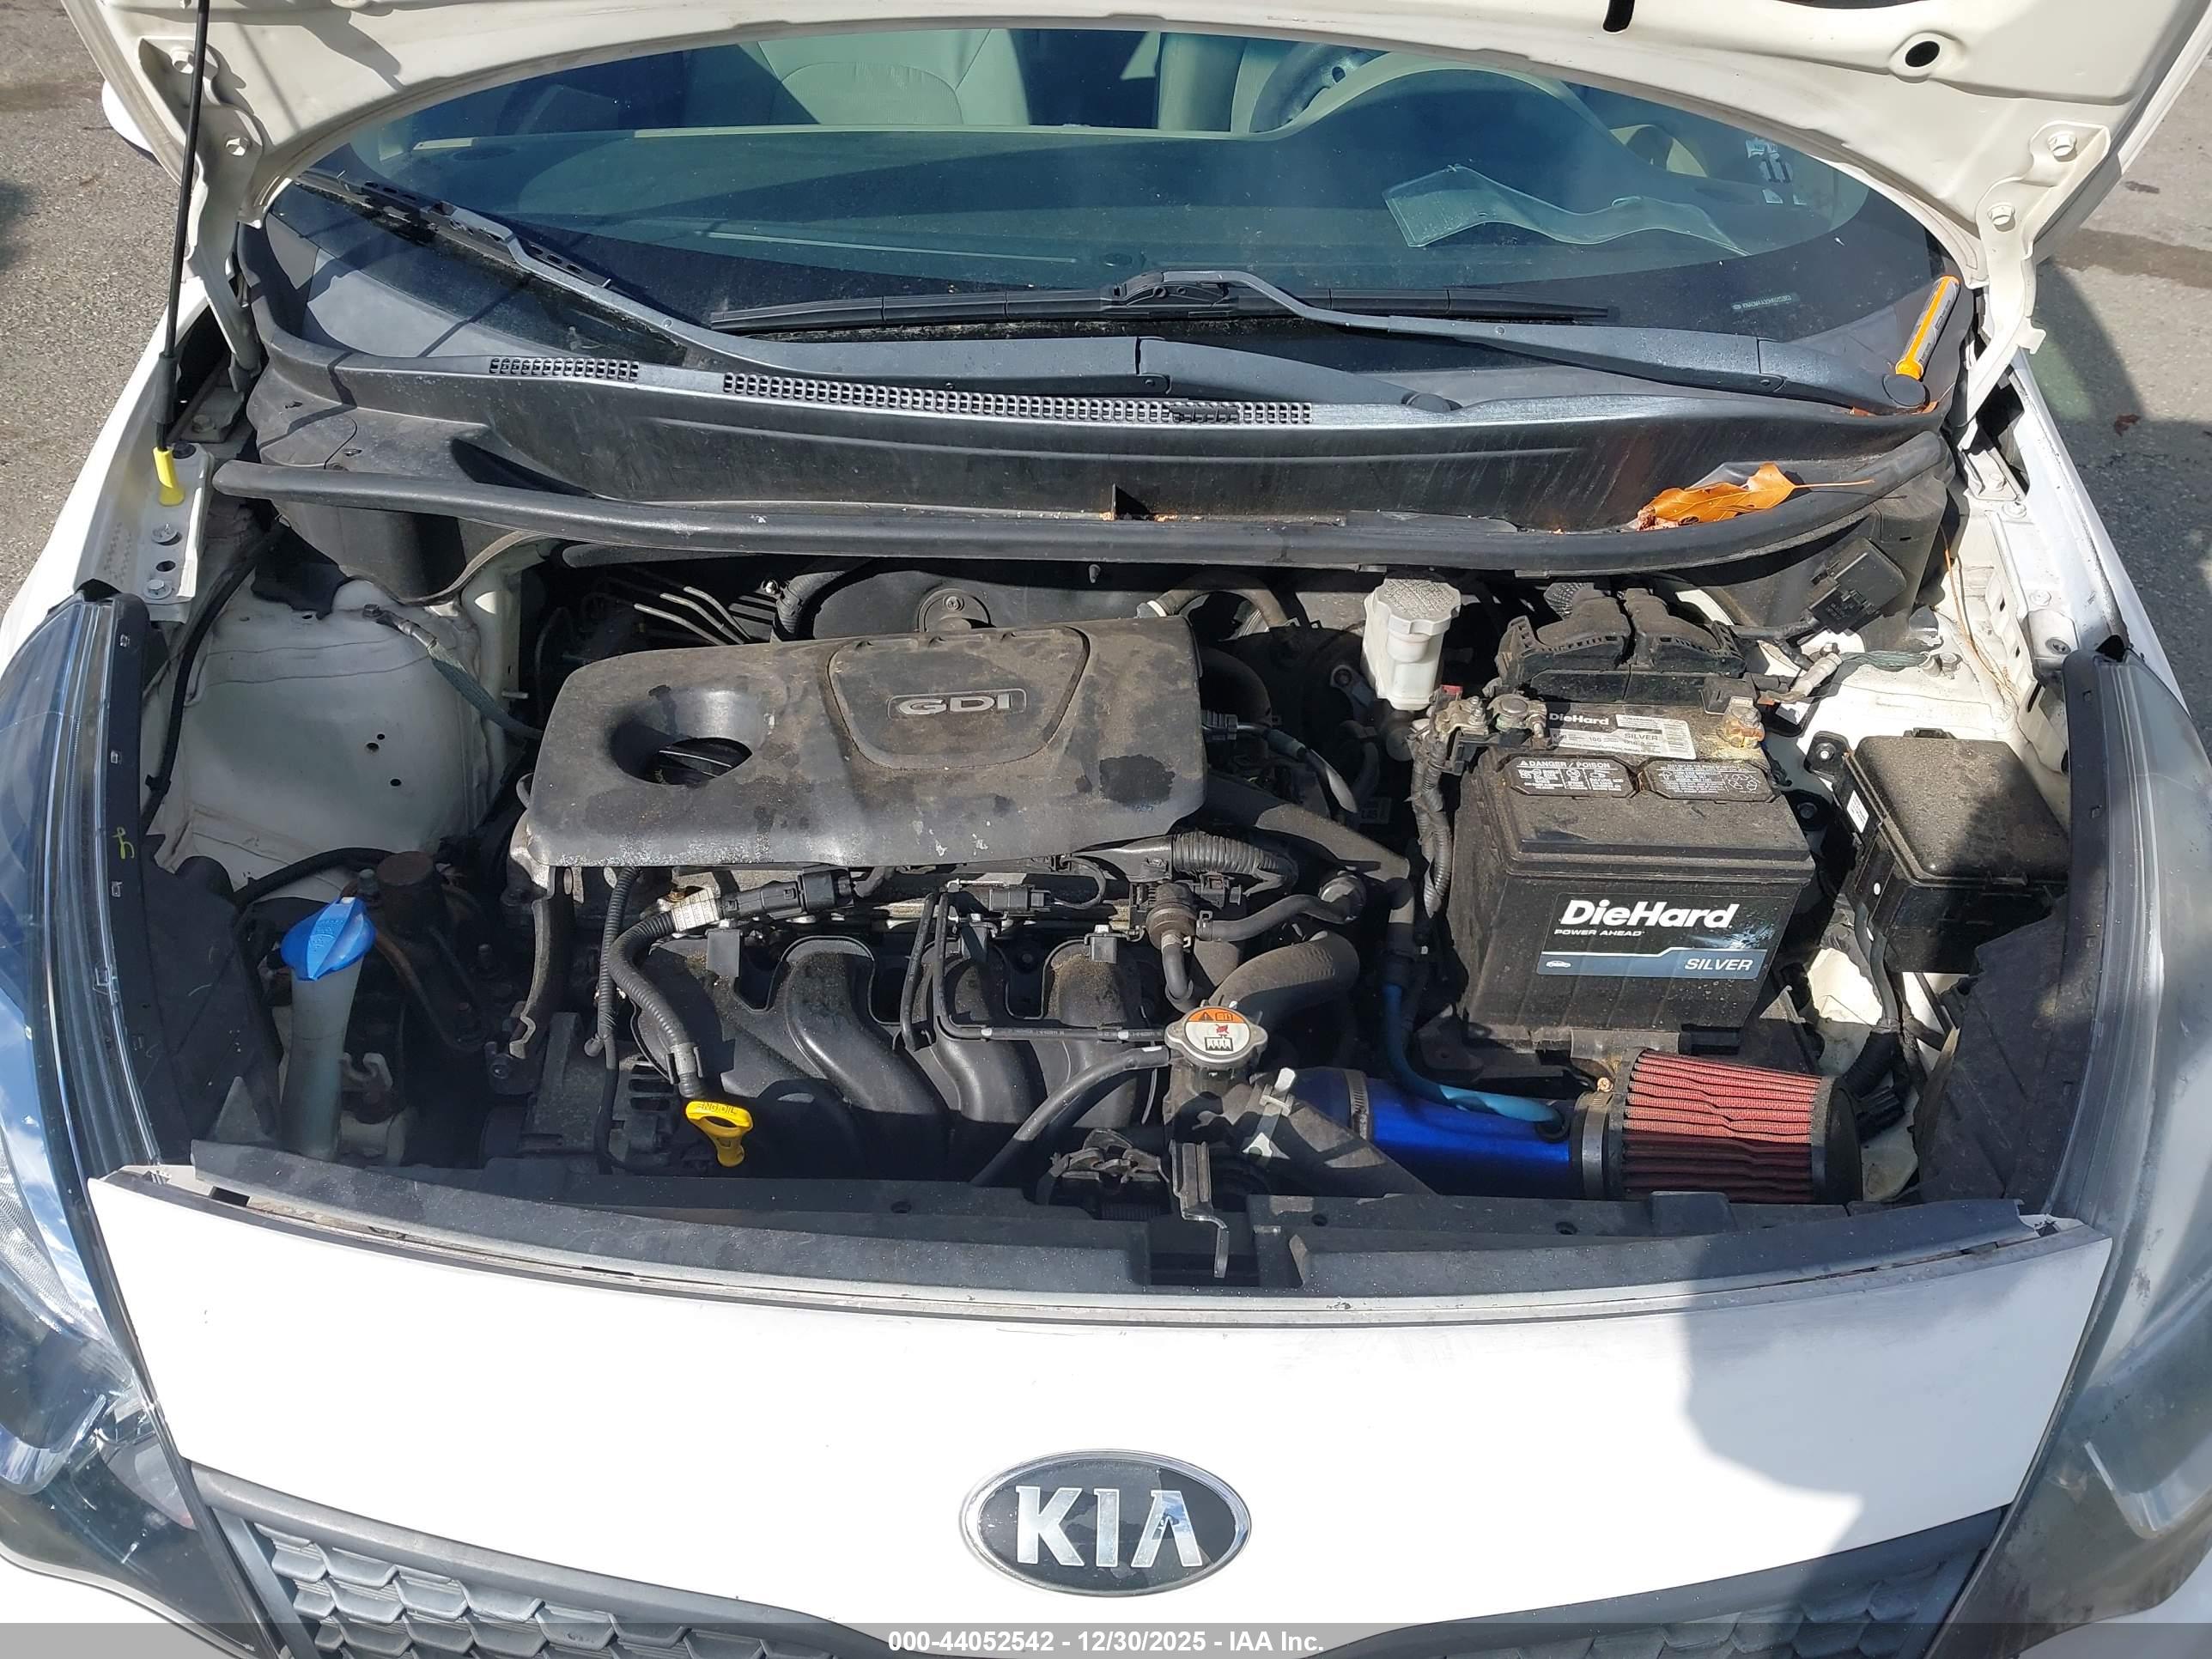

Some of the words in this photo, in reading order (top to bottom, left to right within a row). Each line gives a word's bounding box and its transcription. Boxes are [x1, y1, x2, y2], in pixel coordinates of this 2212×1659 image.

[898, 694, 1012, 715] GDI
[1549, 713, 1610, 726] DieHard
[1624, 732, 1658, 741] SILVER
[1560, 899, 1740, 929] DieHard
[1684, 958, 1753, 971] SILVER
[1016, 1486, 1203, 1568] KIA
